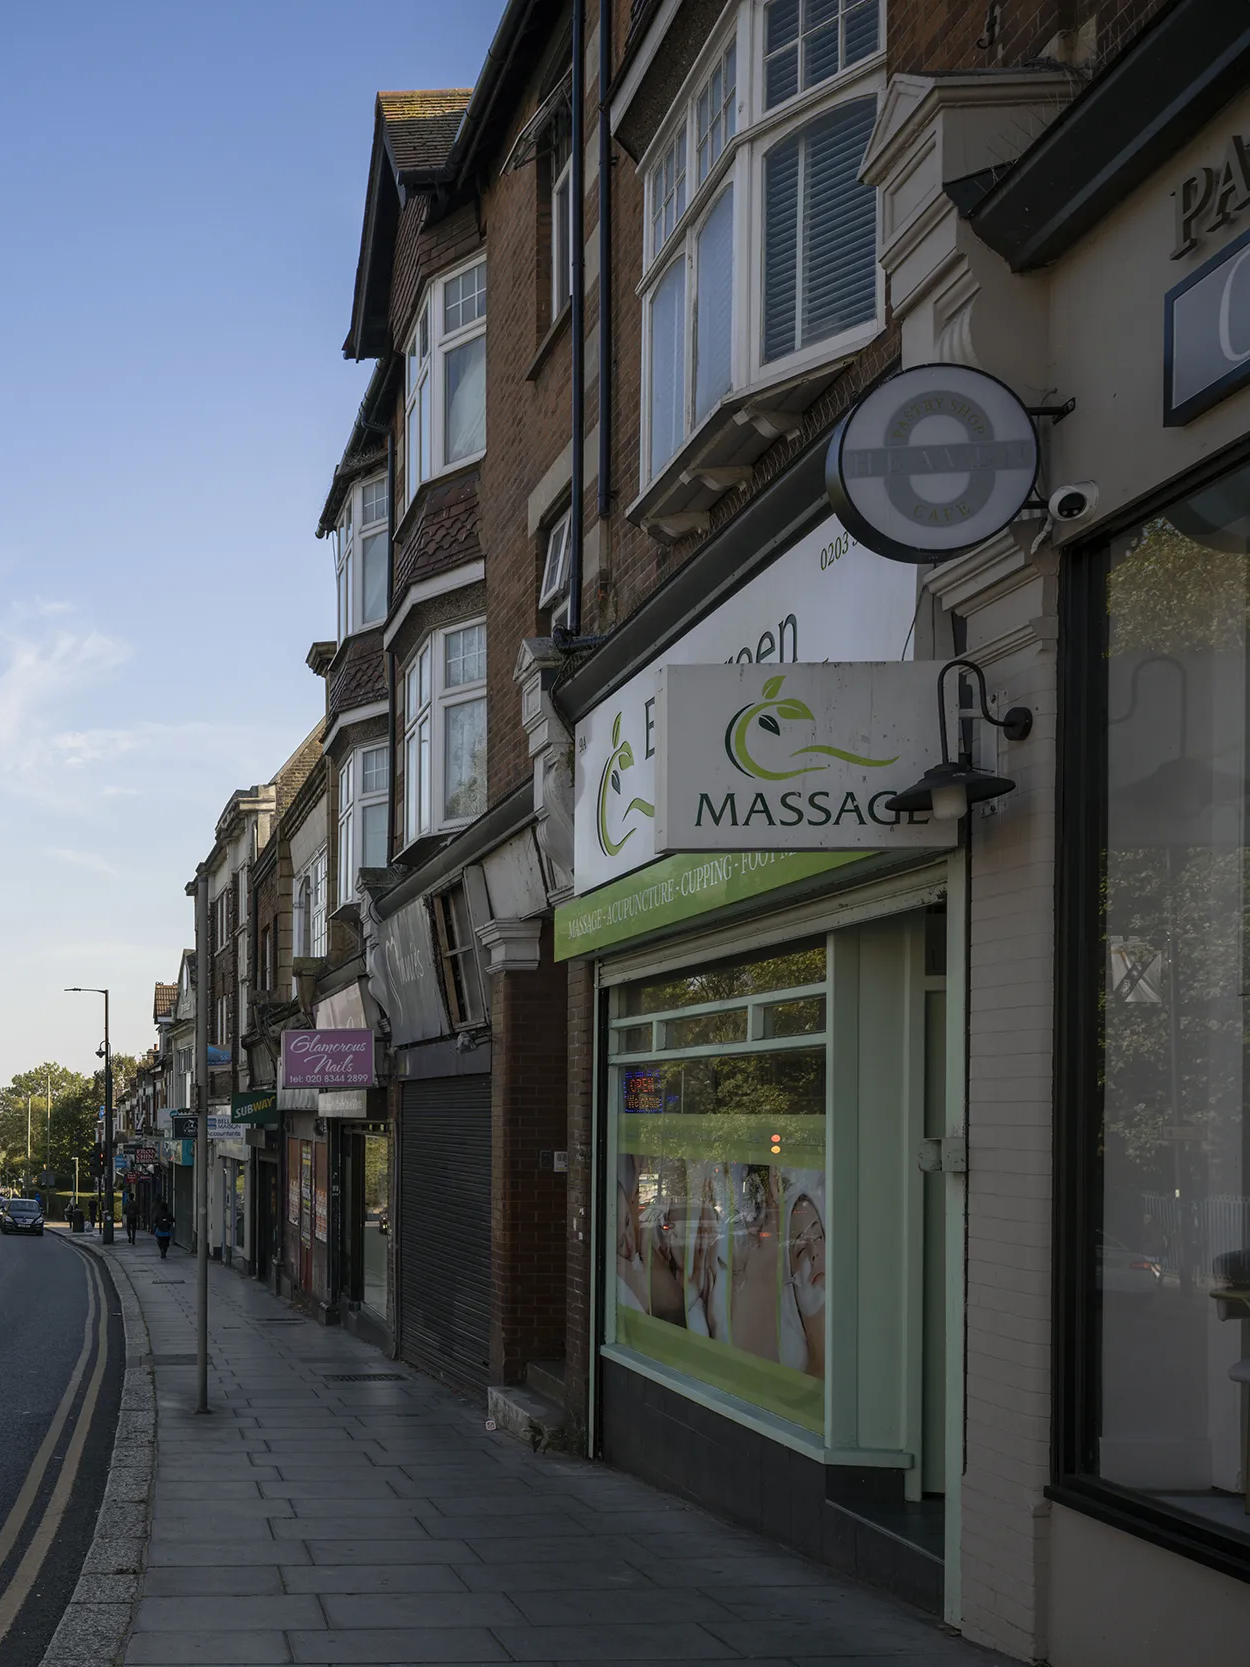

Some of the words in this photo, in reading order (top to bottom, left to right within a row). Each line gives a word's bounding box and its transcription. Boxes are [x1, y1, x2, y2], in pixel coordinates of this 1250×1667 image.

[892, 397, 945, 440] PASTRY
[950, 398, 986, 436] SHOP
[568, 908, 603, 940] MASSAGE
[606, 879, 674, 926] ACUPUNCTURE
[680, 854, 732, 897] CUPPING
[290, 1034, 367, 1054] Glamorous
[303, 1053, 354, 1074] Nails
[290, 1075, 303, 1083] tel:
[306, 1075, 322, 1083] 020
[324, 1075, 345, 1083] 8344
[348, 1074, 369, 1083] 2899
[630, 1077, 655, 1092] OPEN
[234, 1096, 276, 1119] SUBWAY
